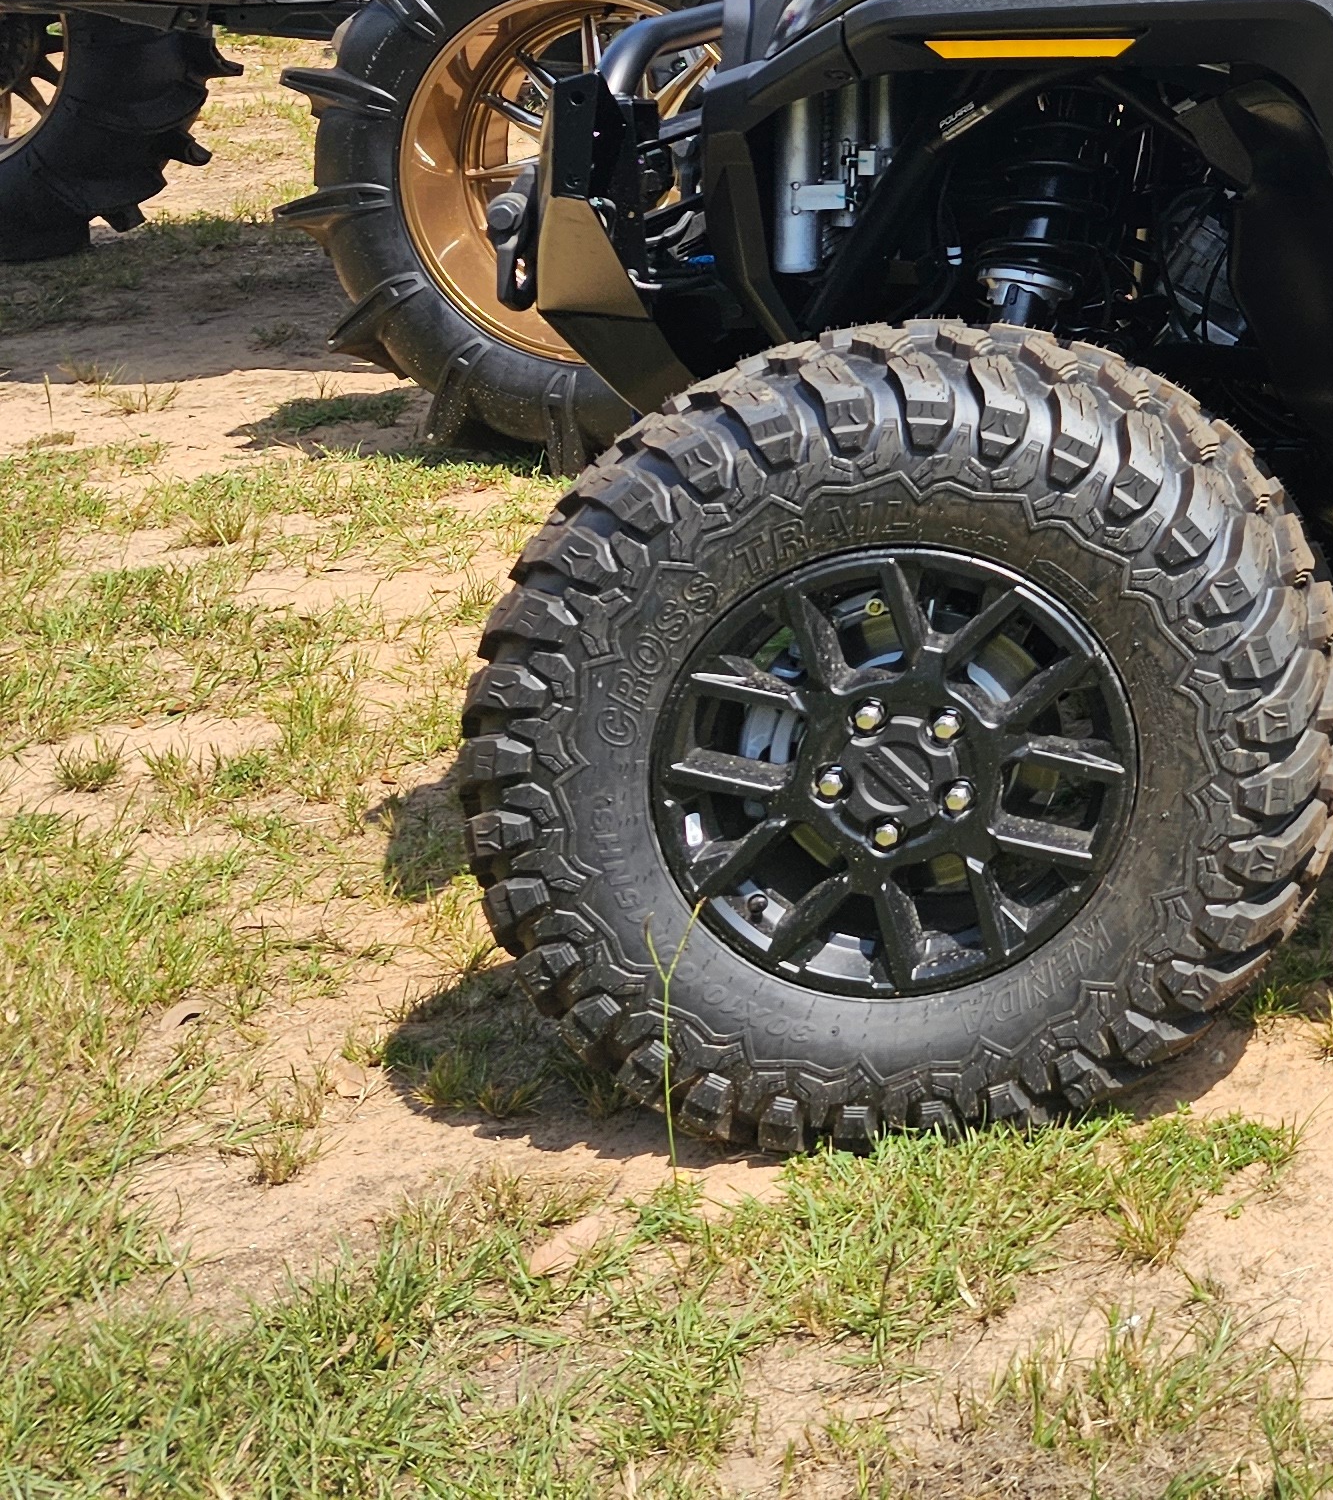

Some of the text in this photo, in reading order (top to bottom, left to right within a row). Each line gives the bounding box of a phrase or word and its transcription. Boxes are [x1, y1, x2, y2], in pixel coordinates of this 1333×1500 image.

[598, 500, 911, 748] CROSS TRAIL
[959, 913, 1113, 1035] KENDA
